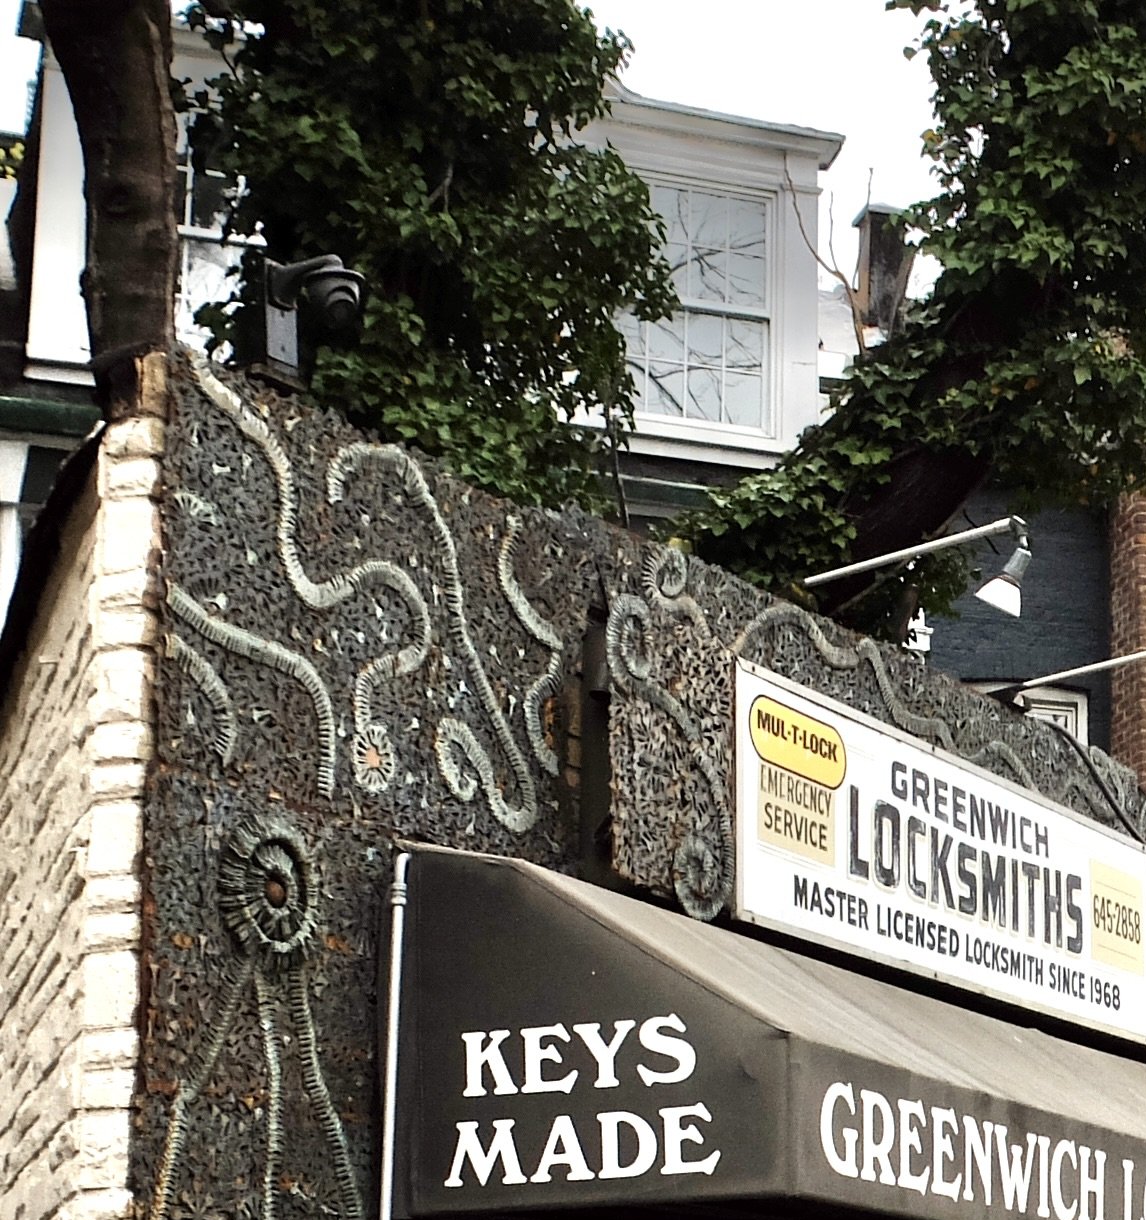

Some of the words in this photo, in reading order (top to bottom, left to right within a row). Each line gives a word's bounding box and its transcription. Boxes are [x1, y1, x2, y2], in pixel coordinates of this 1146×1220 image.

[760, 763, 832, 817] EMERGENCY
[764, 803, 828, 852] SERVICE
[891, 760, 1049, 858] GREENWICH
[850, 786, 1083, 954] LOCKSMITHS
[794, 875, 869, 930] MASTER
[877, 904, 960, 957] LICENSED
[965, 934, 1044, 989] LOCKSMITH
[1049, 964, 1086, 1001] SINCE
[1090, 978, 1121, 1011] 1968
[1093, 894, 1142, 944] 645-2858
[461, 1013, 697, 1097] KEYS
[444, 1102, 721, 1187] MADE
